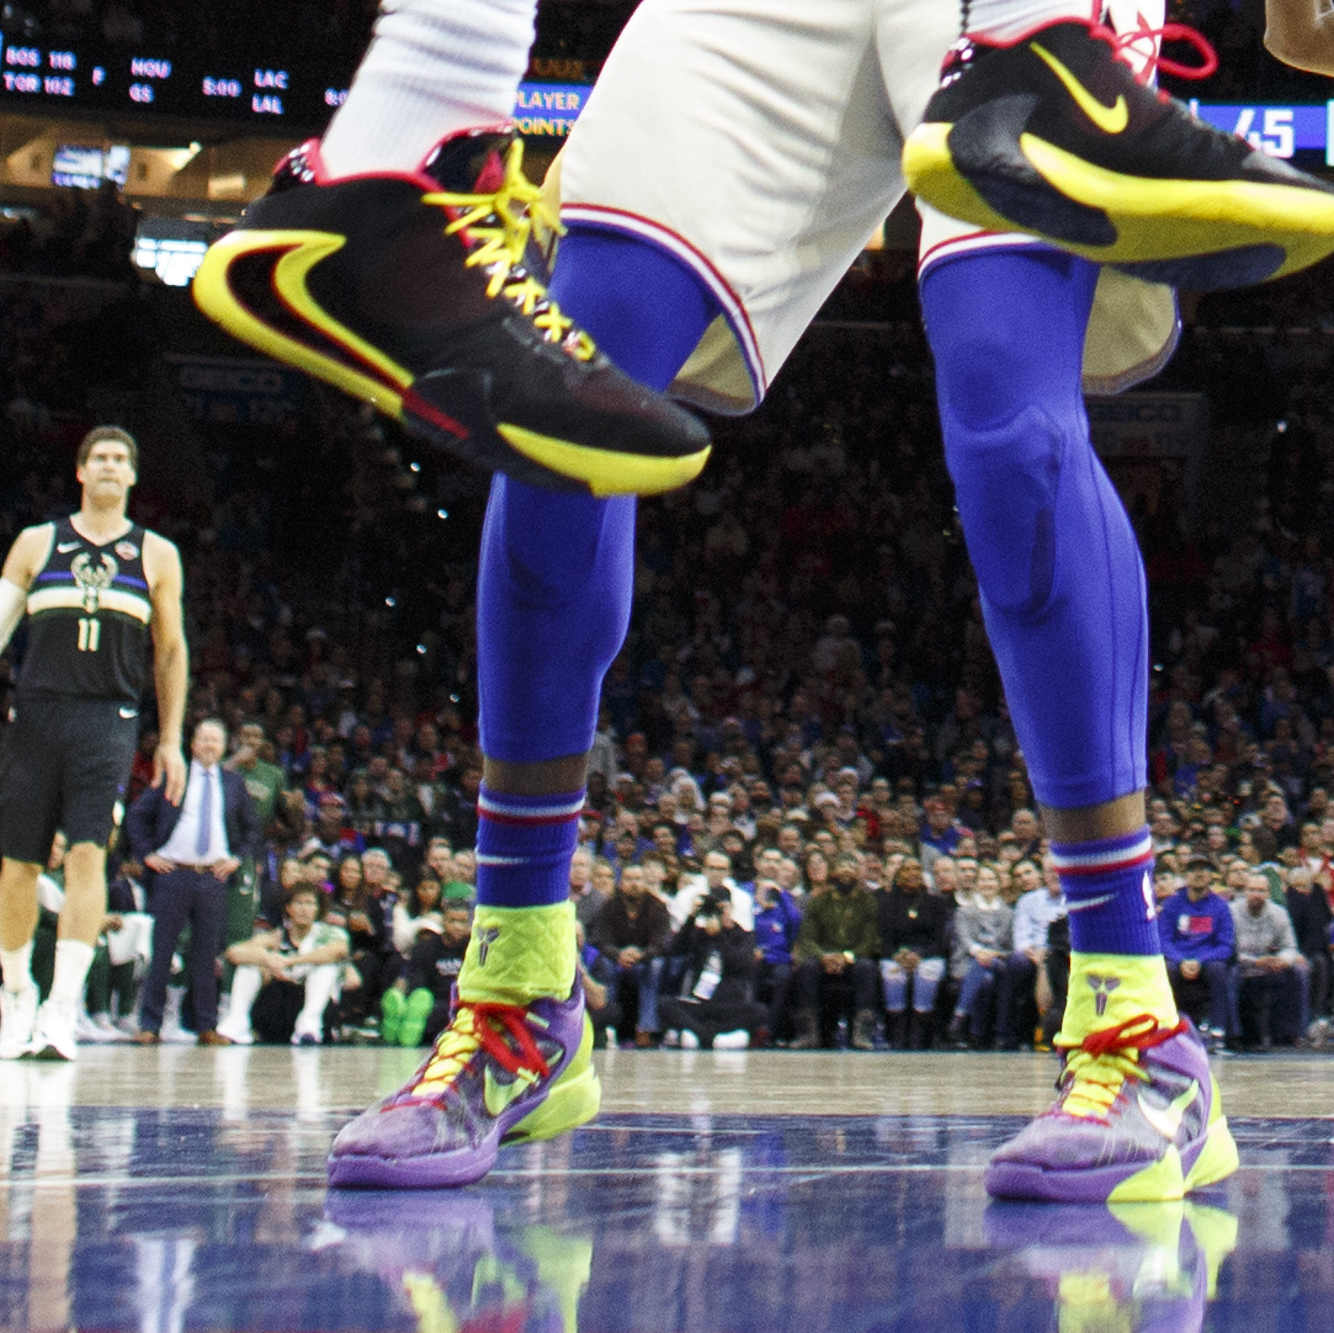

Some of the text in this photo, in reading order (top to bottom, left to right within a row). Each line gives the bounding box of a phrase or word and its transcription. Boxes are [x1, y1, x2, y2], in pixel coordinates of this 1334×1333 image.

[6, 46, 41, 67] BOS
[131, 57, 172, 79] HOU
[254, 68, 289, 89] LAC
[3, 71, 75, 96] TOR 102
[129, 84, 154, 103] GS
[252, 94, 284, 114] LAL
[516, 90, 580, 110] LAYER
[77, 618, 100, 652] 11
